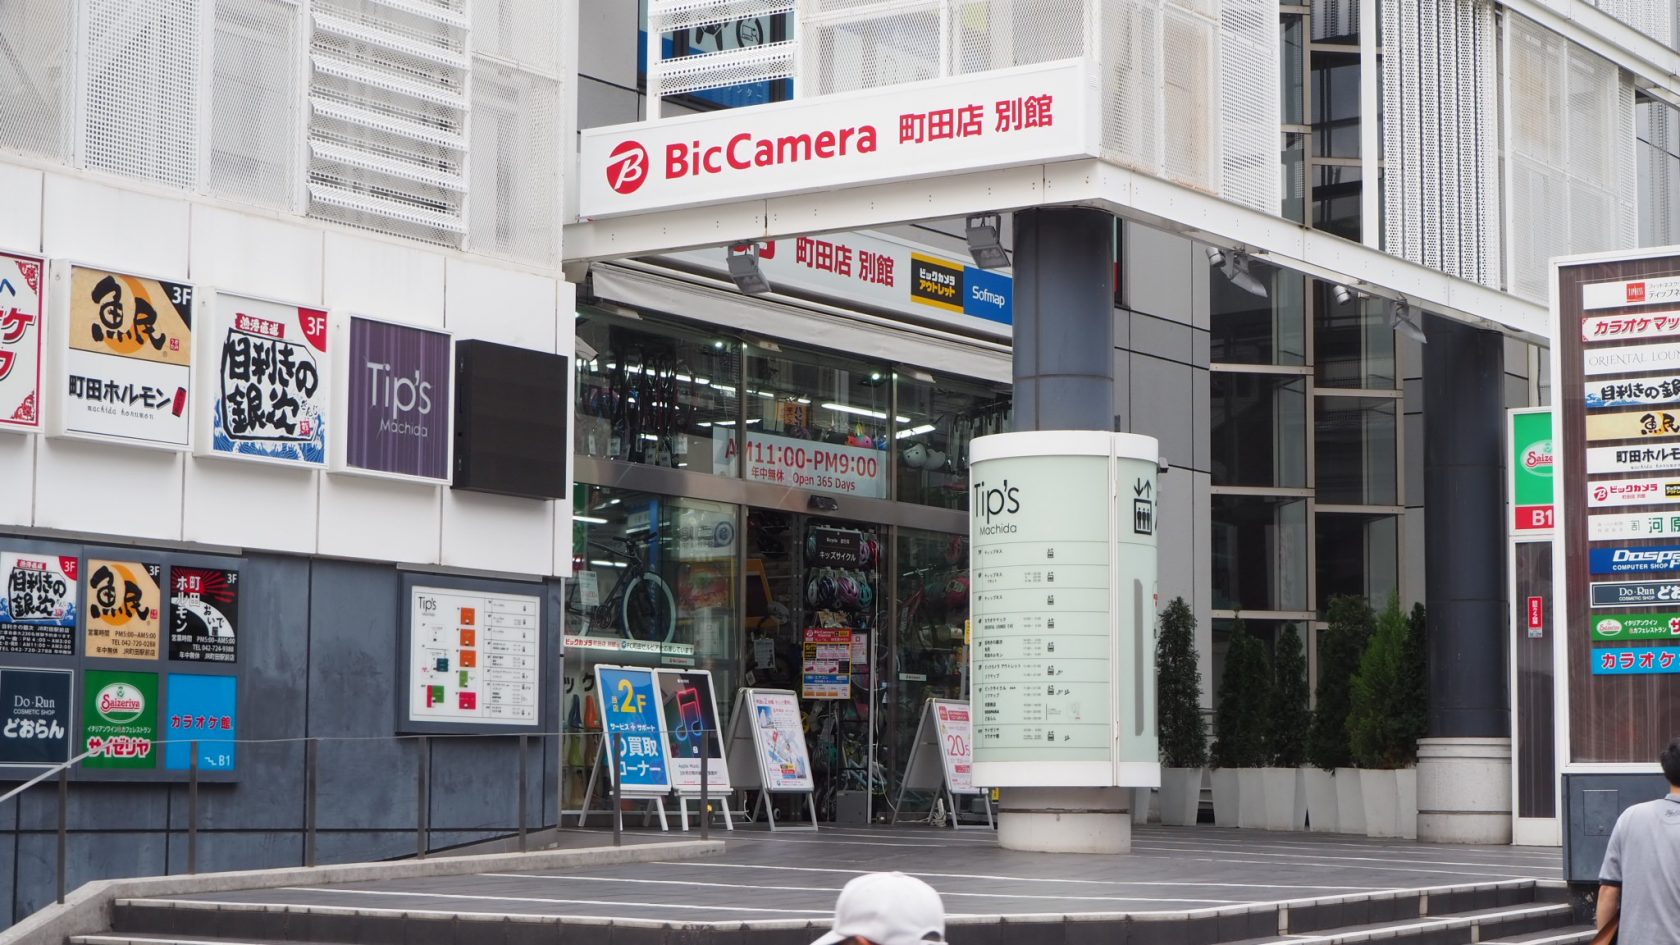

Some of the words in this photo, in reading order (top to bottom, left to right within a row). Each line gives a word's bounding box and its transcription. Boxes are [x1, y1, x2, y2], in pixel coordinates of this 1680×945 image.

[899, 104, 984, 145] 町田店
[994, 94, 1053, 132] 別館
[665, 124, 877, 180] BicCamera
[796, 236, 853, 278] 町田店
[858, 250, 894, 288] 別館
[918, 267, 956, 286] ビックカメラ
[172, 286, 192, 305] 3F
[918, 279, 956, 298] アウトレット
[972, 285, 1006, 309] Sofmap
[91, 275, 166, 350] 魚民
[306, 316, 325, 337] 3F
[1594, 316, 1680, 336] カラオケマッ
[228, 336, 319, 399] 目利きの
[1588, 353, 1645, 368] ORIENTAL
[68, 374, 171, 411] 町田ホルモン
[367, 361, 433, 419] Tip's
[226, 382, 300, 436] 銀次
[380, 417, 428, 438] Machida
[1640, 412, 1680, 435] 魚民
[751, 467, 785, 482] 年中無休
[793, 473, 815, 489] Open
[817, 475, 833, 488] 365
[835, 478, 856, 493] Days
[1610, 484, 1658, 494] ビックカメラ
[974, 480, 1020, 524] Tip's
[1532, 510, 1552, 526] B1
[980, 523, 1017, 536] Machida
[64, 561, 75, 572] 3F
[819, 551, 857, 562] キッズサイクル
[150, 566, 160, 576] 3F
[227, 573, 238, 584] 3F
[13, 570, 66, 598] 目利きの
[90, 566, 149, 620] 魚民
[190, 576, 201, 607] 町田
[12, 592, 55, 617] 銀次
[176, 576, 188, 633] ホルモン
[418, 596, 437, 612] Tip's
[88, 629, 110, 637] 営業時間
[1624, 619, 1658, 627] イタリアンワイン
[1602, 653, 1675, 669] カラオケ
[101, 694, 141, 713] Saizeriya
[617, 678, 647, 713] 2F
[3, 718, 65, 739] どおらん
[171, 716, 233, 730] カラオケ館
[610, 723, 629, 731] サービス
[87, 736, 151, 757] サイゼリヤ
[218, 755, 230, 767] B1
